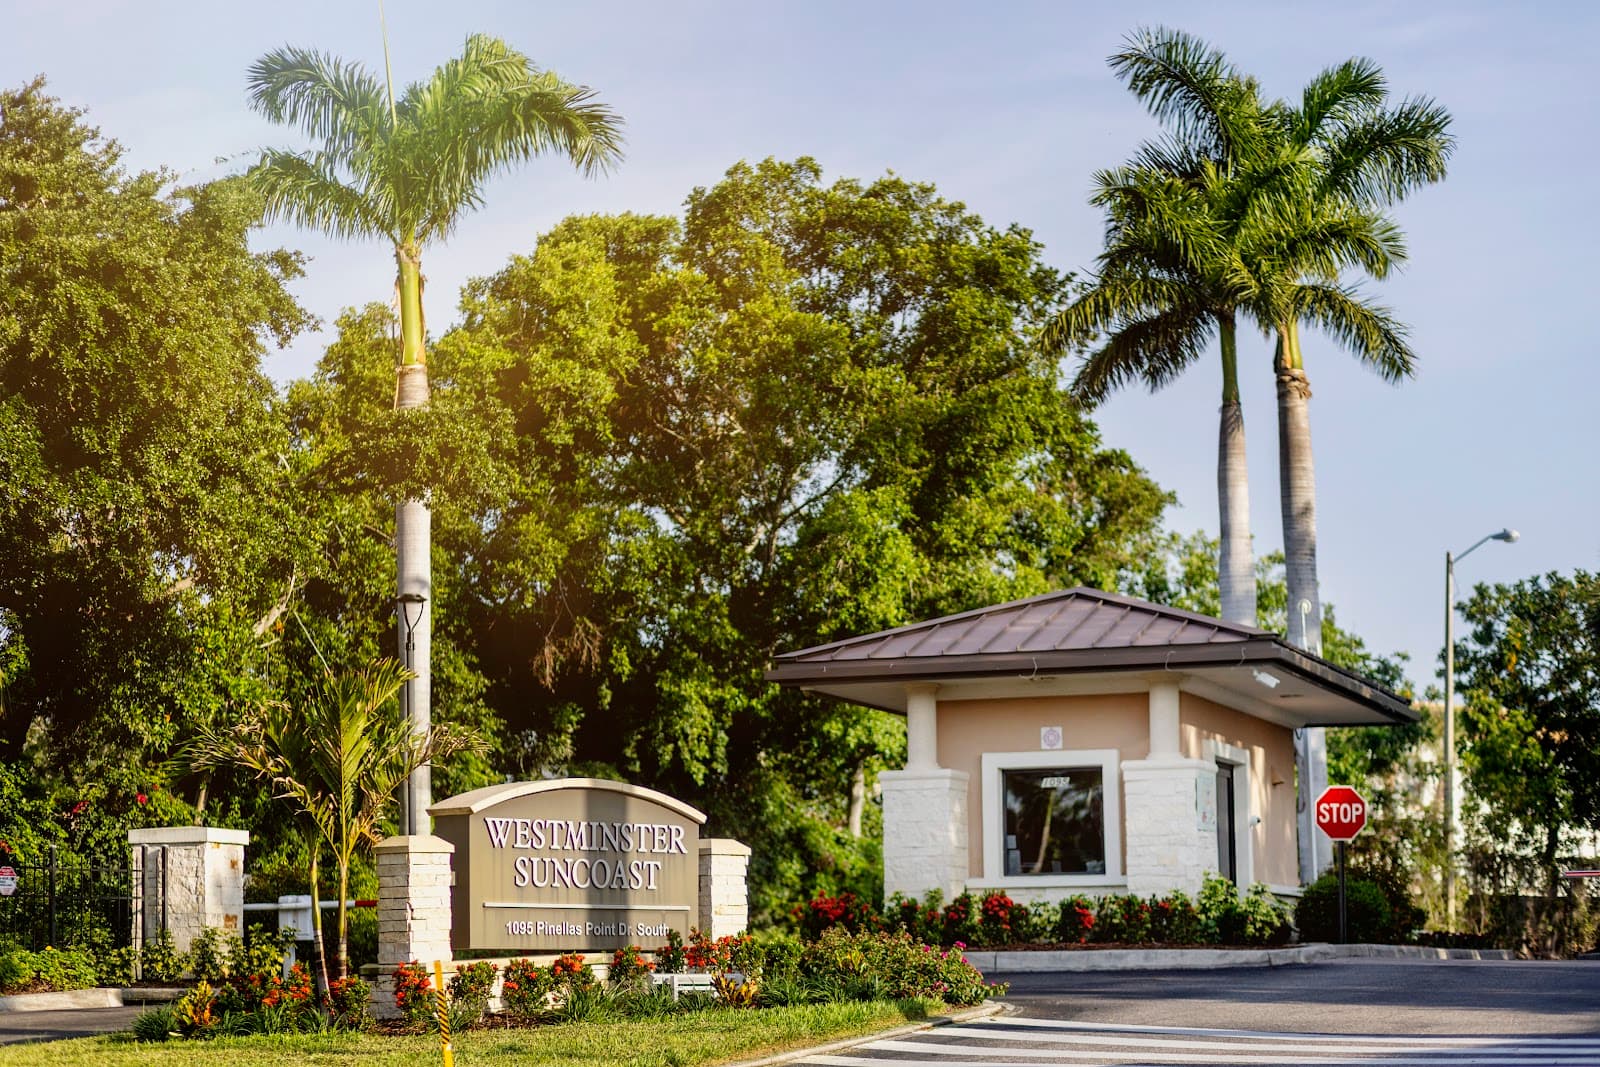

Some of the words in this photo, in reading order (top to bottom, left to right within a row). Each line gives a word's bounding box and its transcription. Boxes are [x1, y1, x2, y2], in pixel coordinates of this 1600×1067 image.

[1319, 803, 1363, 823] STOP
[484, 817, 687, 854] WESTMINSTER
[514, 856, 661, 890] SUNCOAST
[506, 920, 533, 935] 1095
[535, 920, 582, 936] Pinellas
[586, 922, 614, 937] Point
[618, 922, 634, 937] Dr.
[637, 923, 670, 937] South
